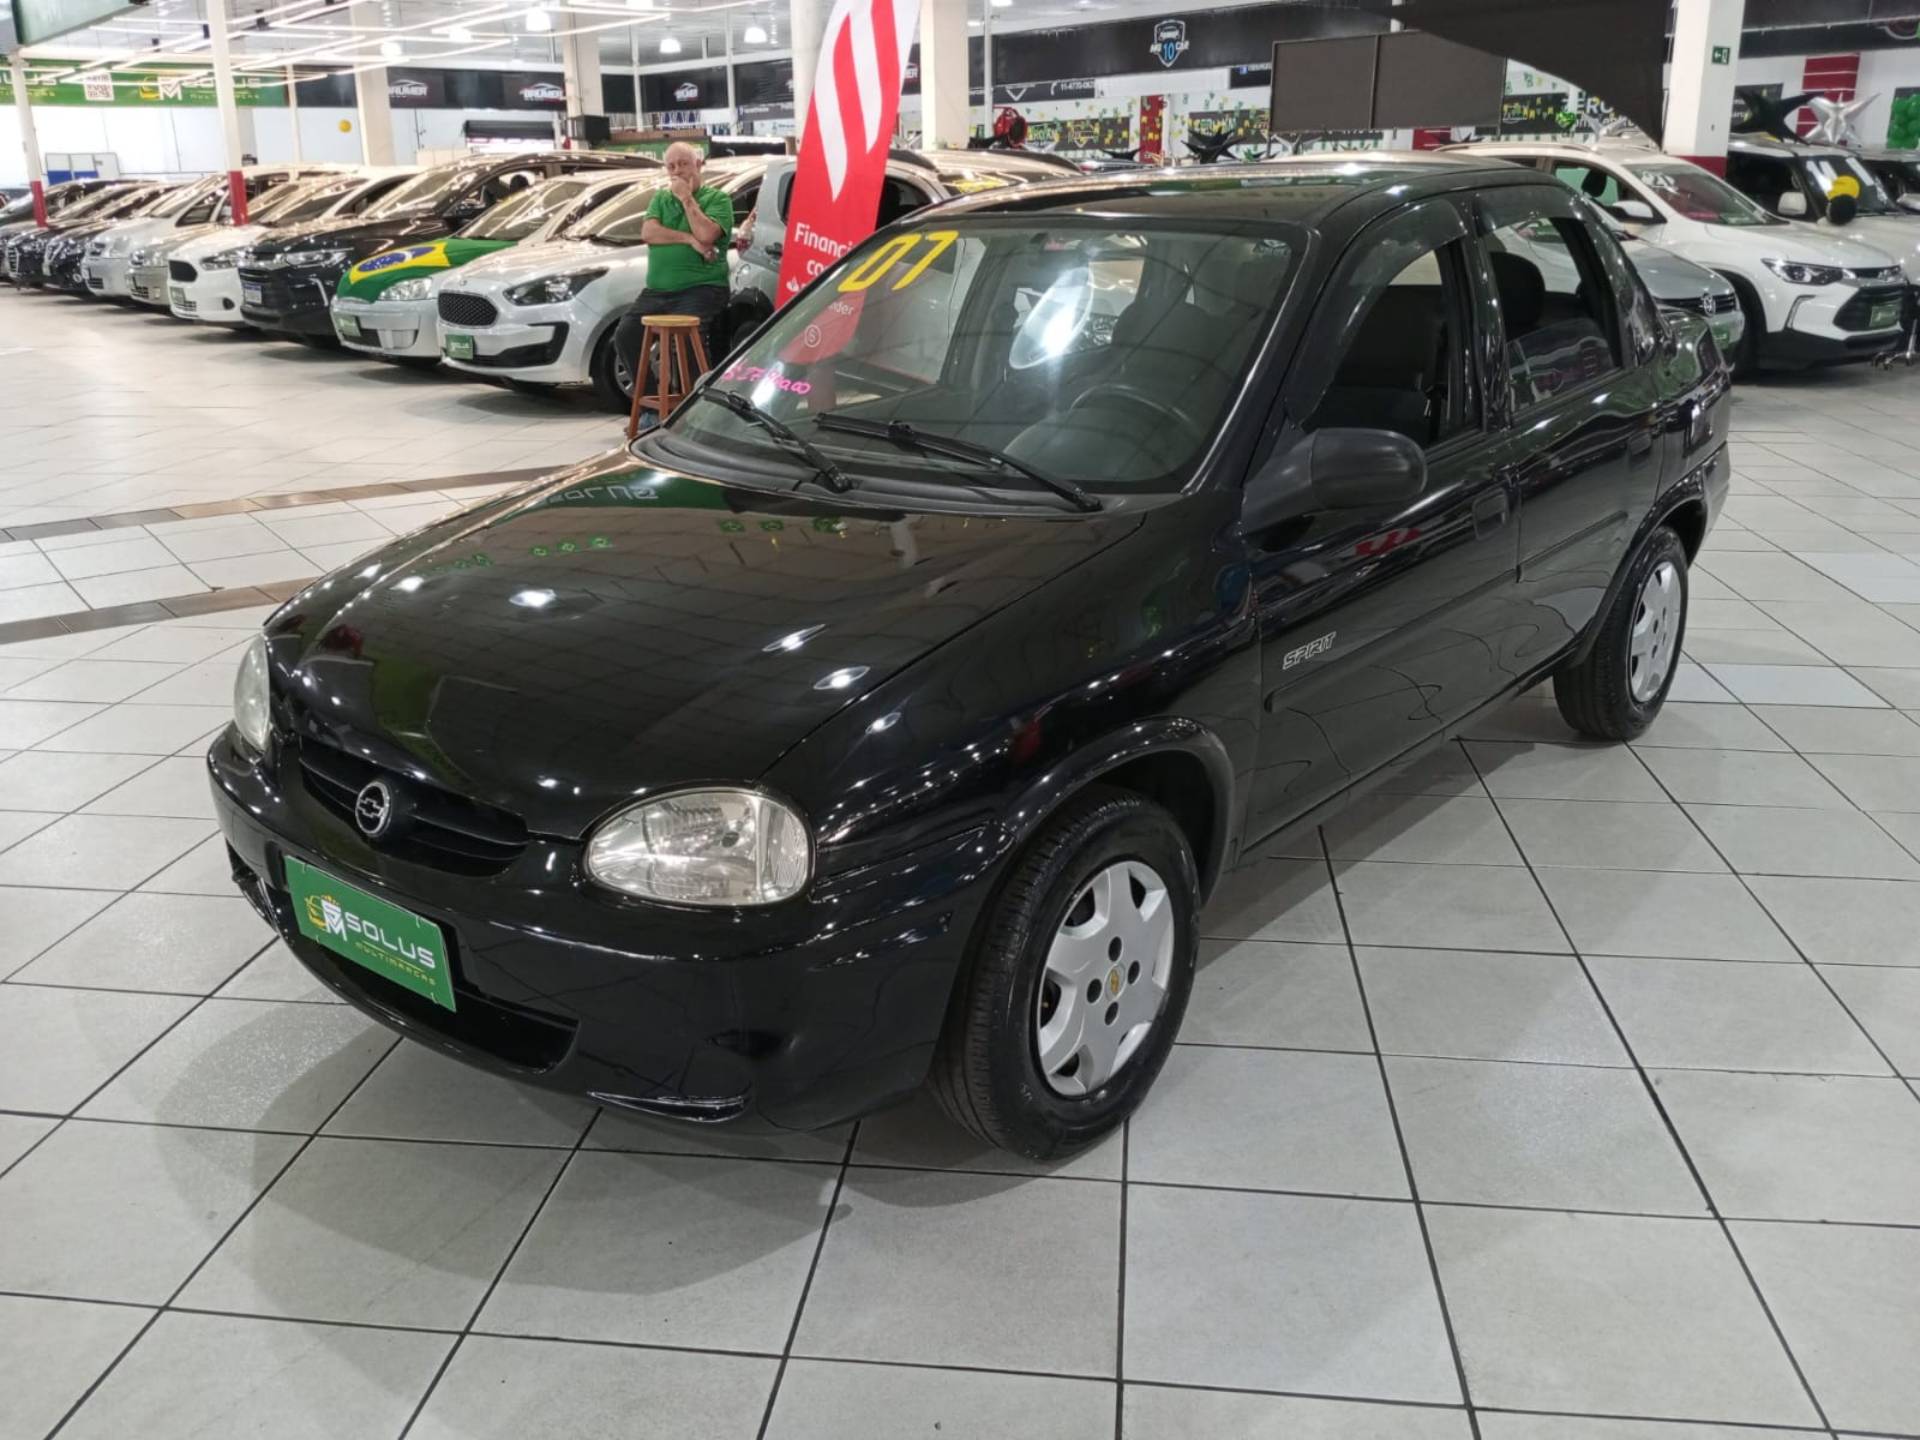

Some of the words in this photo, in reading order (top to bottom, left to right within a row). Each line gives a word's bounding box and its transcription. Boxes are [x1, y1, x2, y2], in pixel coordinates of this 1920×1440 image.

[1163, 42, 1174, 60] 10
[837, 230, 959, 292] 07
[1282, 631, 1337, 670] SPIRIT
[344, 911, 436, 969] SOLUS
